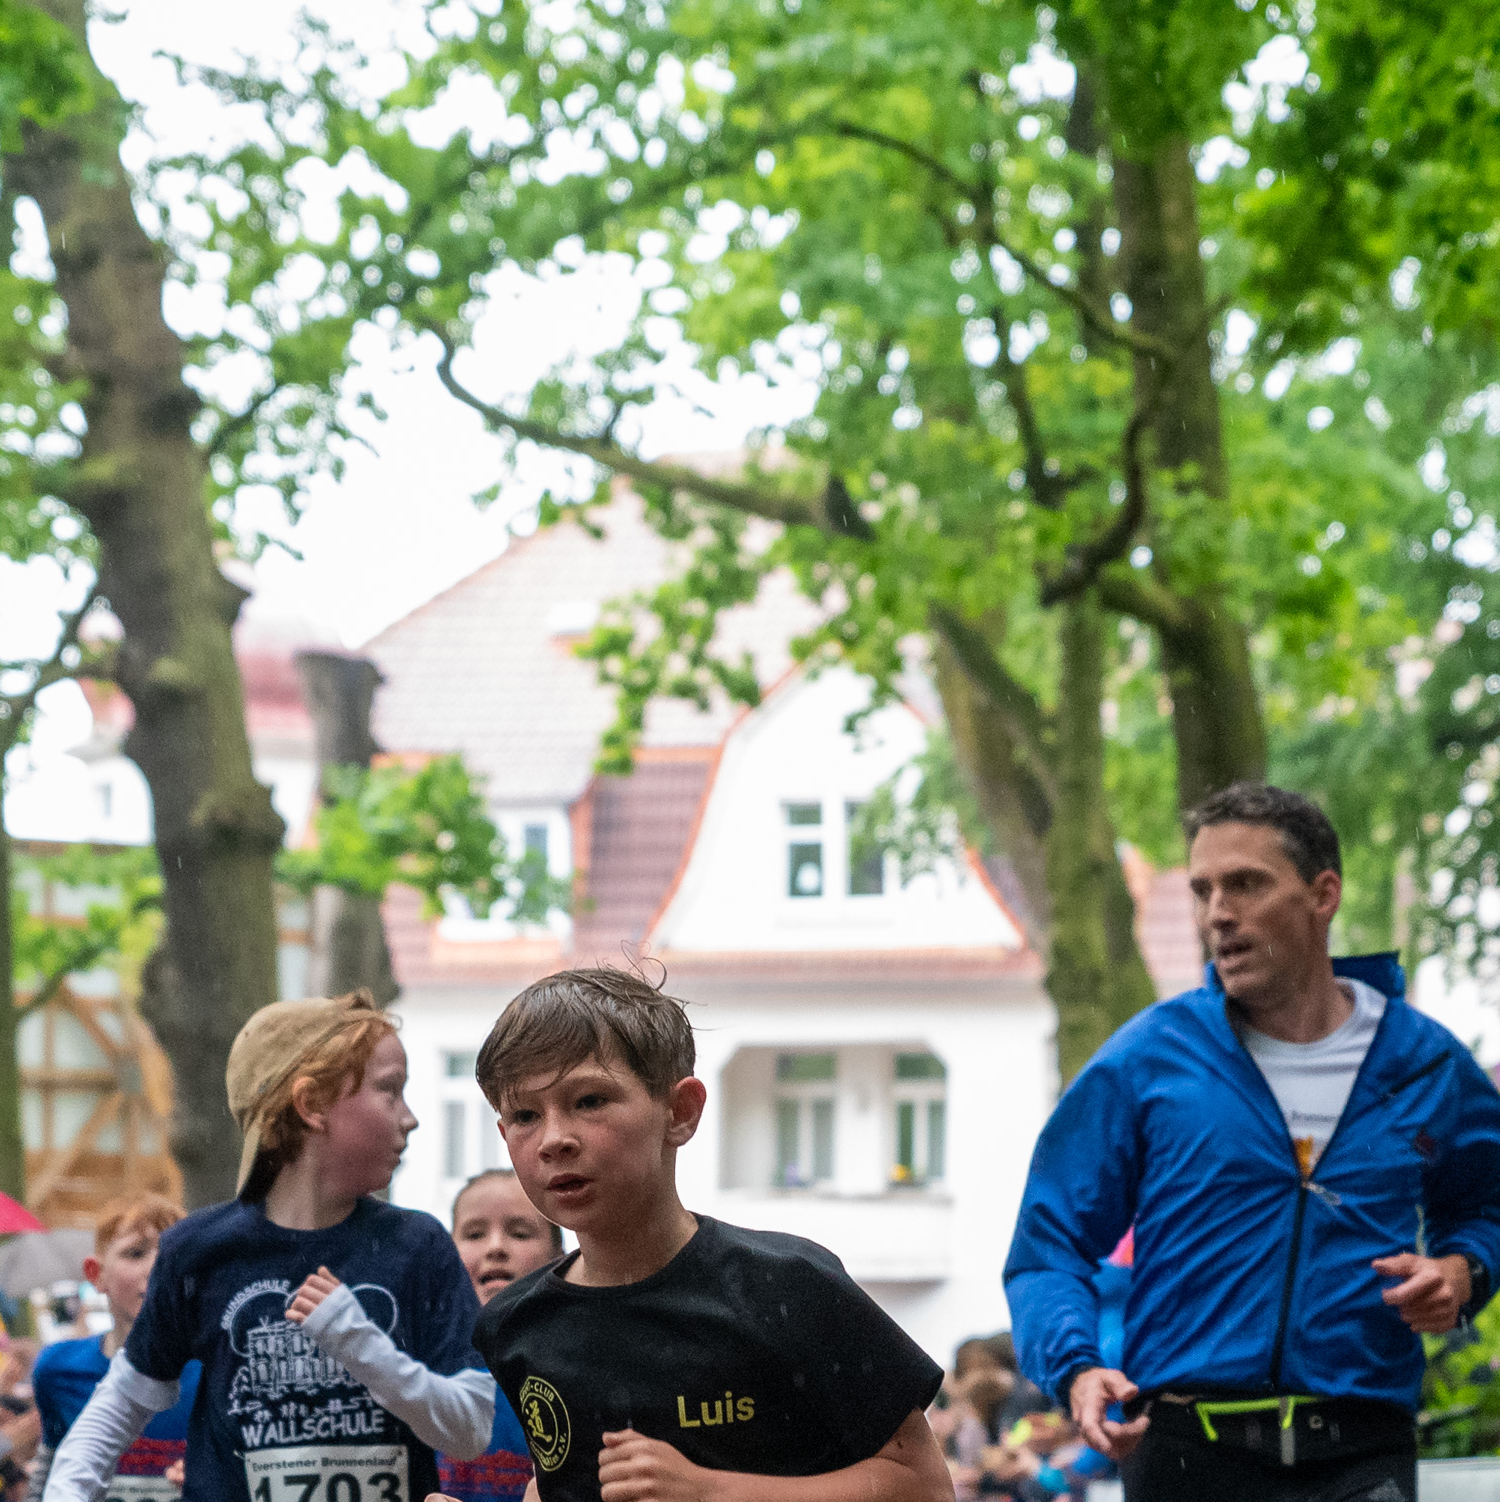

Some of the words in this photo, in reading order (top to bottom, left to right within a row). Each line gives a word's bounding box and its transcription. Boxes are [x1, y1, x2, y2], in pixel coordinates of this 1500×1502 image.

[677, 1390, 756, 1428] Luis
[241, 1409, 385, 1448] WALLSCHULE
[252, 1458, 317, 1472] Everstener
[321, 1456, 398, 1468] Brunnenlauf
